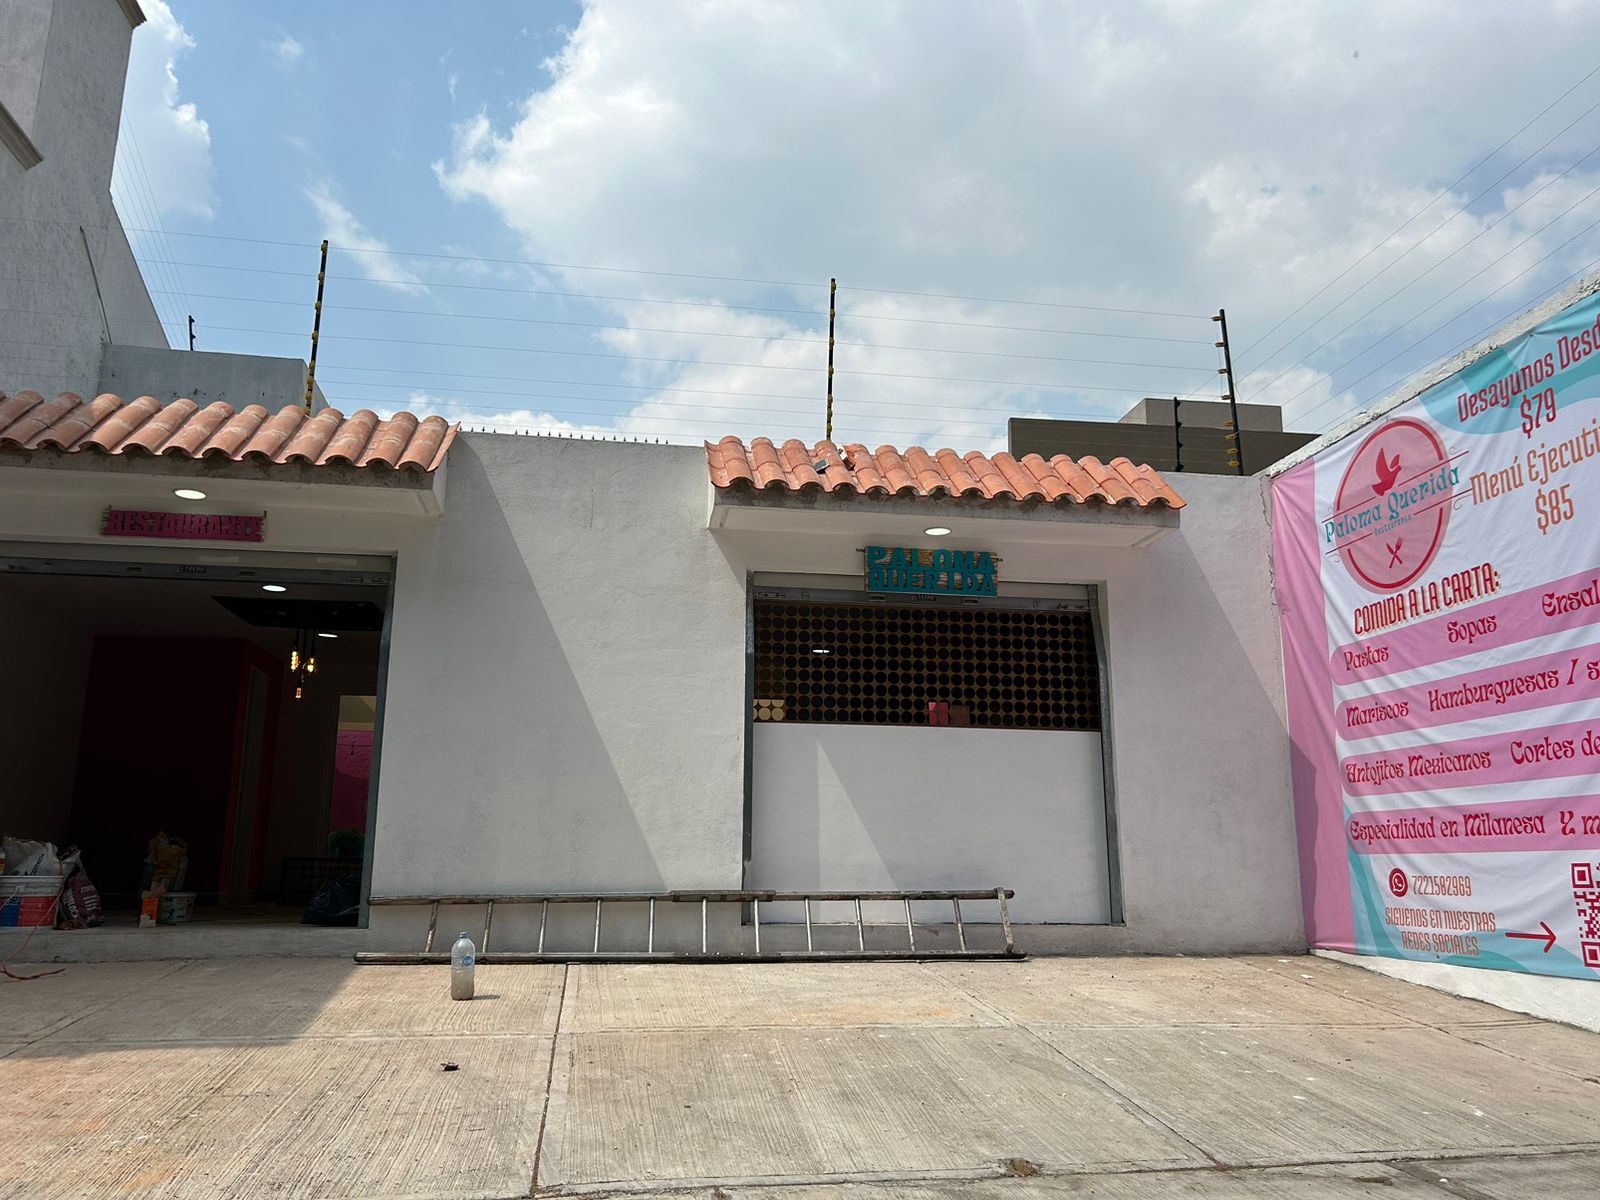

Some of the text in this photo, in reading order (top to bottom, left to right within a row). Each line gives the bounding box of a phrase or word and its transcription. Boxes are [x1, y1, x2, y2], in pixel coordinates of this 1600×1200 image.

[1457, 350, 1555, 423] Desayunos
[1520, 387, 1557, 439] $79
[1469, 418, 1600, 506] Menú Ejecuti
[108, 510, 263, 539] RESTAURANTE
[1325, 464, 1460, 543] Paloma Querida
[1535, 484, 1575, 535] $85
[867, 546, 997, 573] PALOMA
[868, 568, 998, 596] QUERIDA
[1354, 562, 1501, 636] COMIDA A LA CARTA:
[1344, 646, 1389, 671] Pastas
[1447, 615, 1497, 644] Sopas
[1346, 701, 1409, 727] Mariscos
[1428, 670, 1559, 712] Hamburguesas
[1345, 759, 1404, 786] Antojitos
[1408, 751, 1492, 777] Mexicanos
[1510, 736, 1574, 765] Cortes
[1350, 816, 1435, 845] Especialidad
[1440, 818, 1458, 838] en
[1463, 813, 1545, 837] Milanesa
[1412, 875, 1472, 896] 7221582969
[1385, 906, 1496, 933] SIGUENOS EN NUESTRAS
[1401, 930, 1480, 957] REDES SOCIALES
